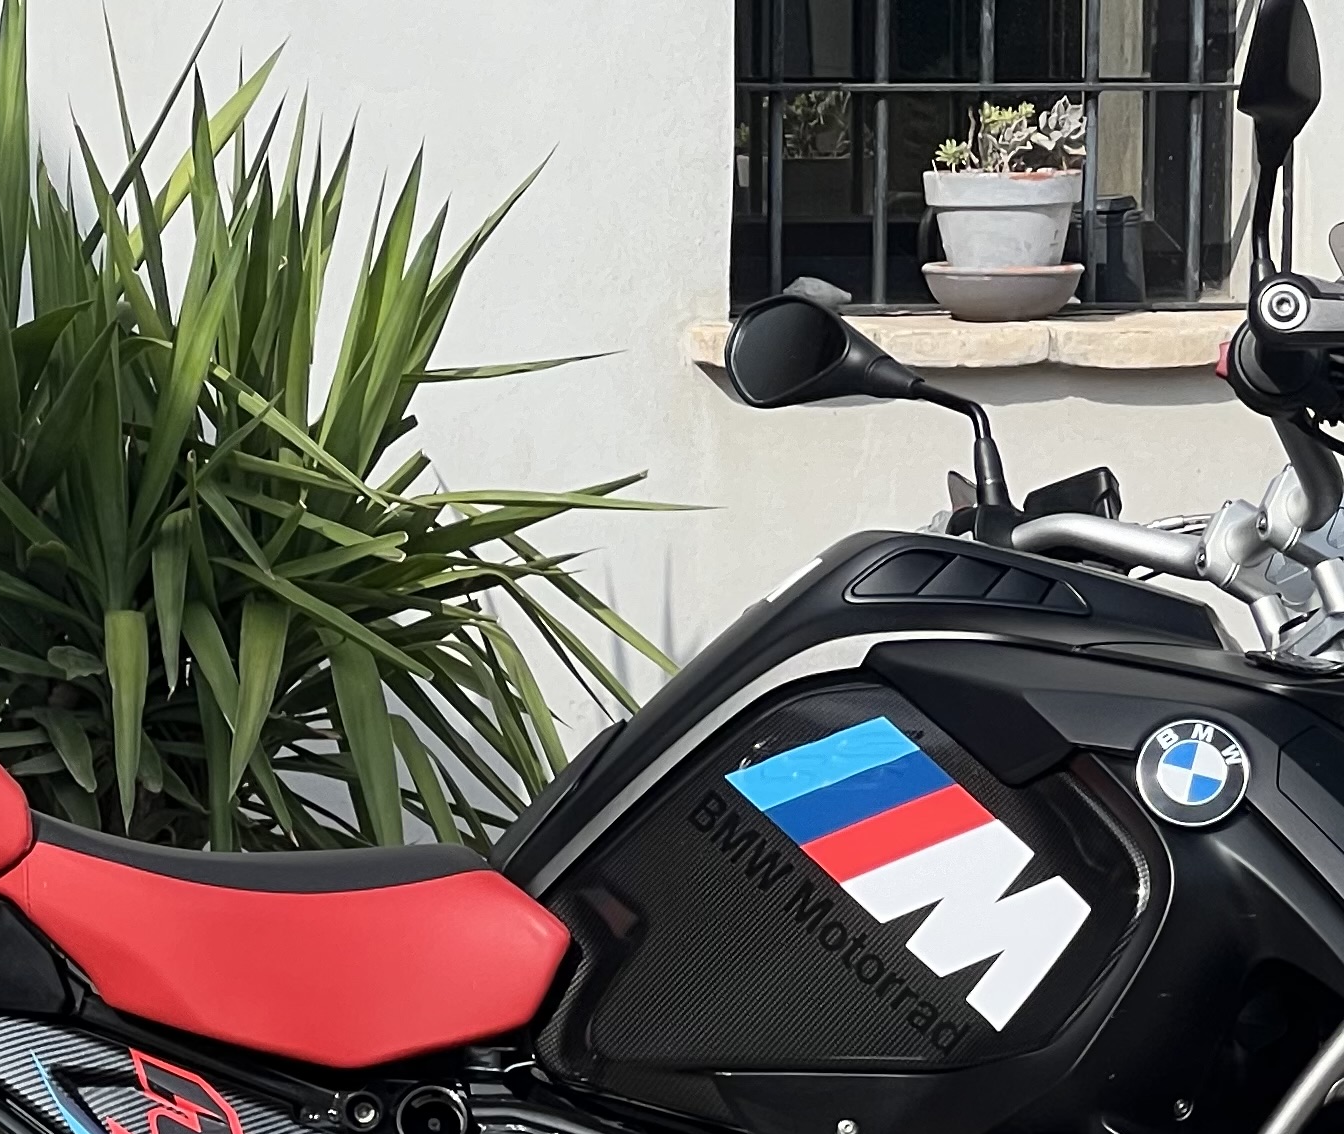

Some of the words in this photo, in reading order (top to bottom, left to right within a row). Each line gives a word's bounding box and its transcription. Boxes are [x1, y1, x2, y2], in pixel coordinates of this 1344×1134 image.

[1156, 724, 1242, 765] BMW
[689, 790, 793, 891] BMW
[784, 879, 970, 1055] Motorrad
[840, 819, 1092, 1032] M
